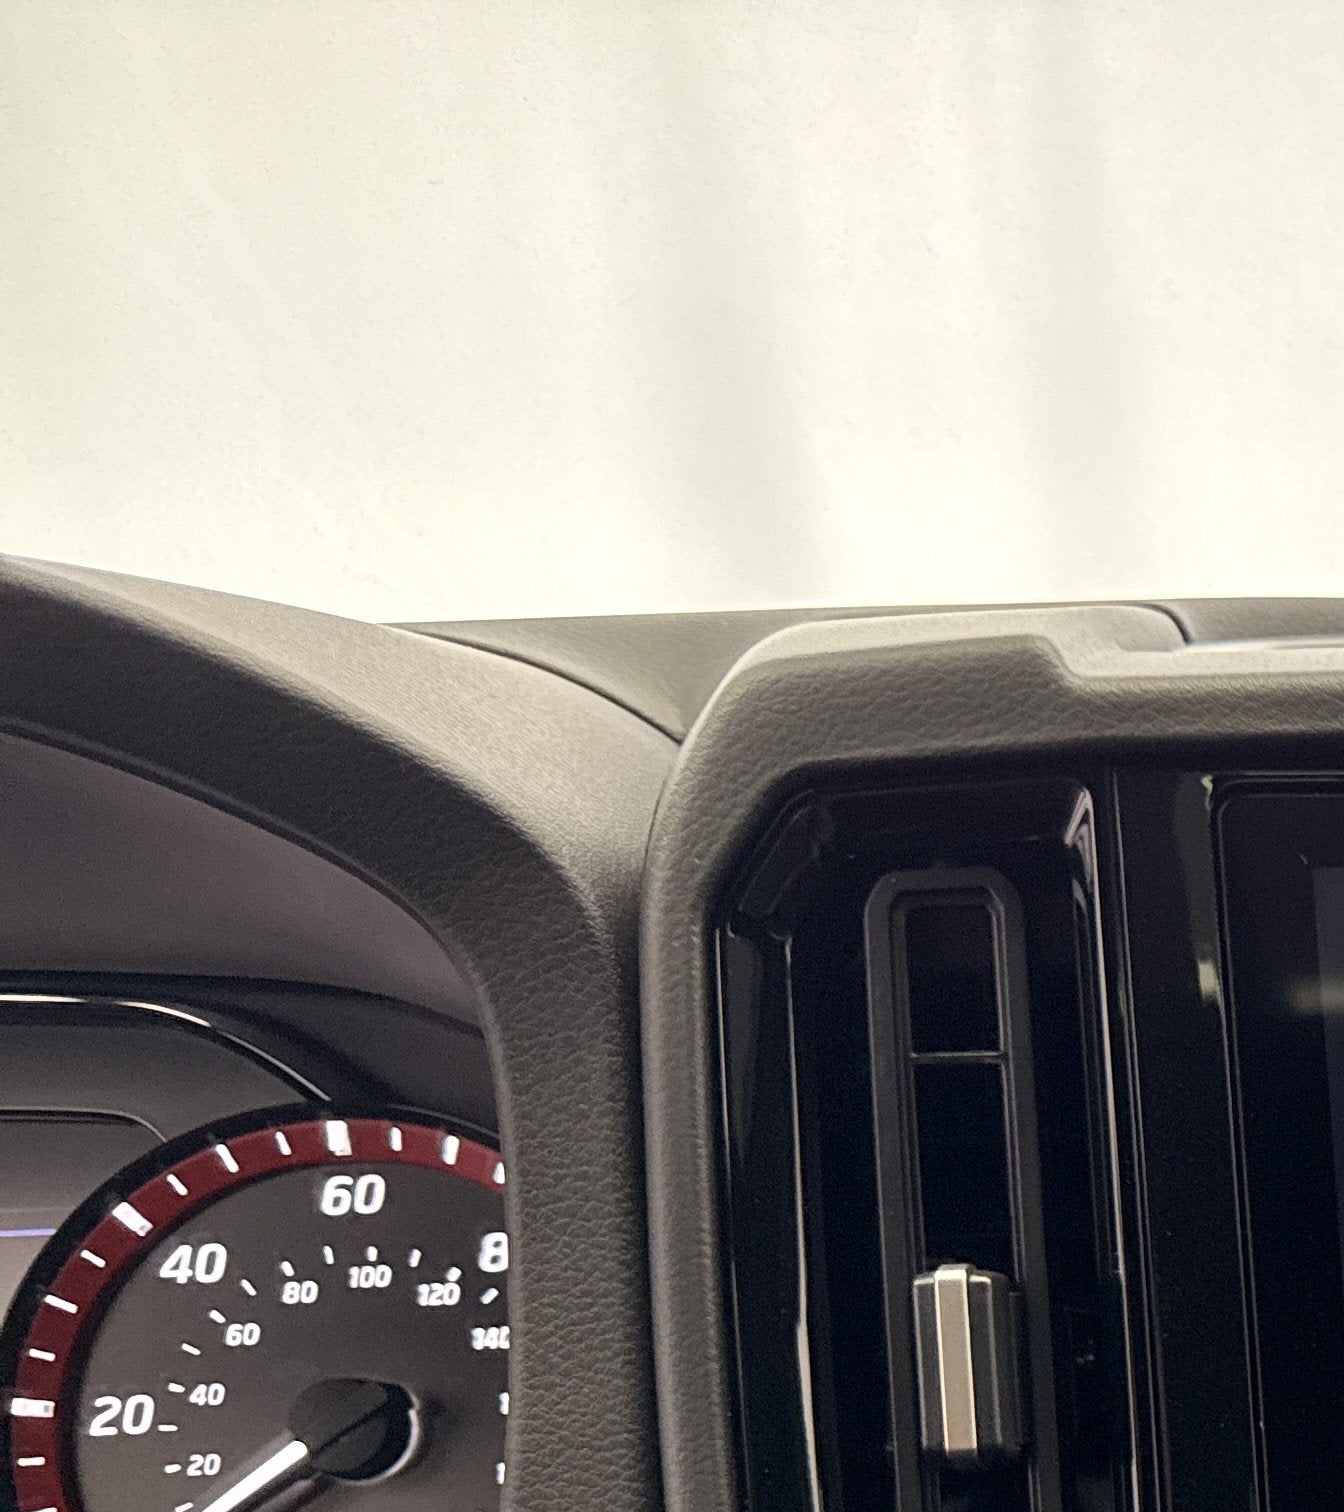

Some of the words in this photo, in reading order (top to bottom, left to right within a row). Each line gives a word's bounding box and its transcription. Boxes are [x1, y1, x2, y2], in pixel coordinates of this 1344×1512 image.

[320, 1173, 386, 1216] 60
[159, 1242, 227, 1285] 40
[477, 1231, 509, 1273] 8
[348, 1264, 393, 1289] 100
[281, 1279, 318, 1304] 80
[417, 1282, 461, 1307] 120
[225, 1322, 261, 1348] 60
[189, 1382, 226, 1407] 40
[89, 1395, 156, 1437] 20
[186, 1452, 222, 1477] 20
